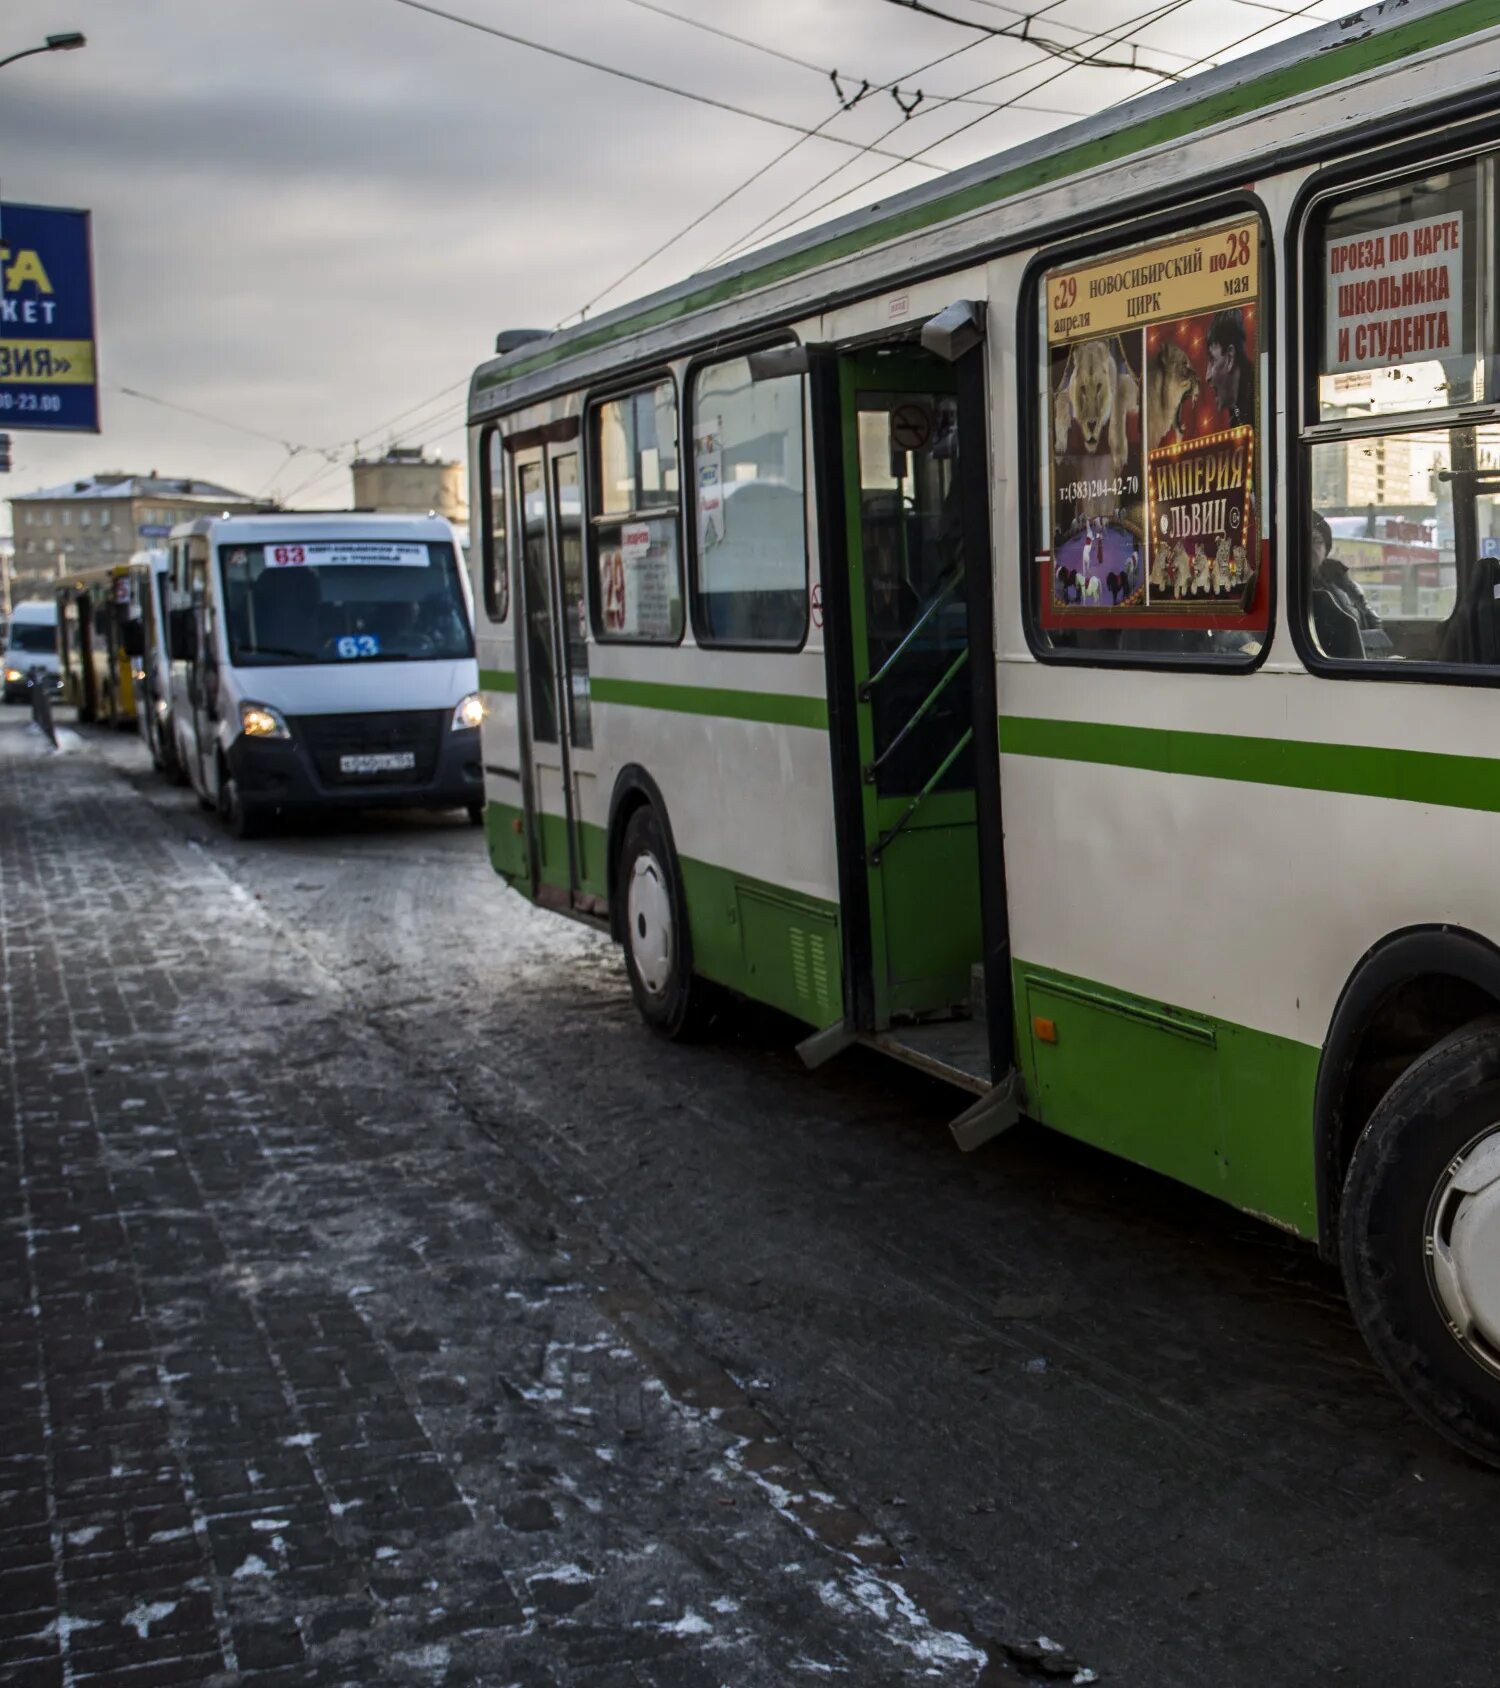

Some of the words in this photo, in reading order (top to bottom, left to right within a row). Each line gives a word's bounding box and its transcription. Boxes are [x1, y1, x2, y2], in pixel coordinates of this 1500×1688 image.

[1089, 248, 1203, 298] НОВОСИБИРСКИЙ
[1331, 236, 1385, 274] ПРОЕЗД
[1390, 231, 1408, 263] ПО
[1413, 220, 1459, 258] КАРТЕ
[1054, 311, 1090, 337] апреля
[1126, 292, 1161, 319] ЦИРК
[1224, 275, 1250, 297] мая
[1338, 265, 1450, 318] ШКОЛЬНИКА
[1338, 328, 1350, 363] И
[1355, 311, 1450, 361] СТУДЕНТА
[1157, 448, 1243, 501] ИМПЕРИЯ
[1169, 498, 1227, 540] ЛЬВИЦ
[274, 546, 305, 565] 63
[337, 636, 379, 658] 63
